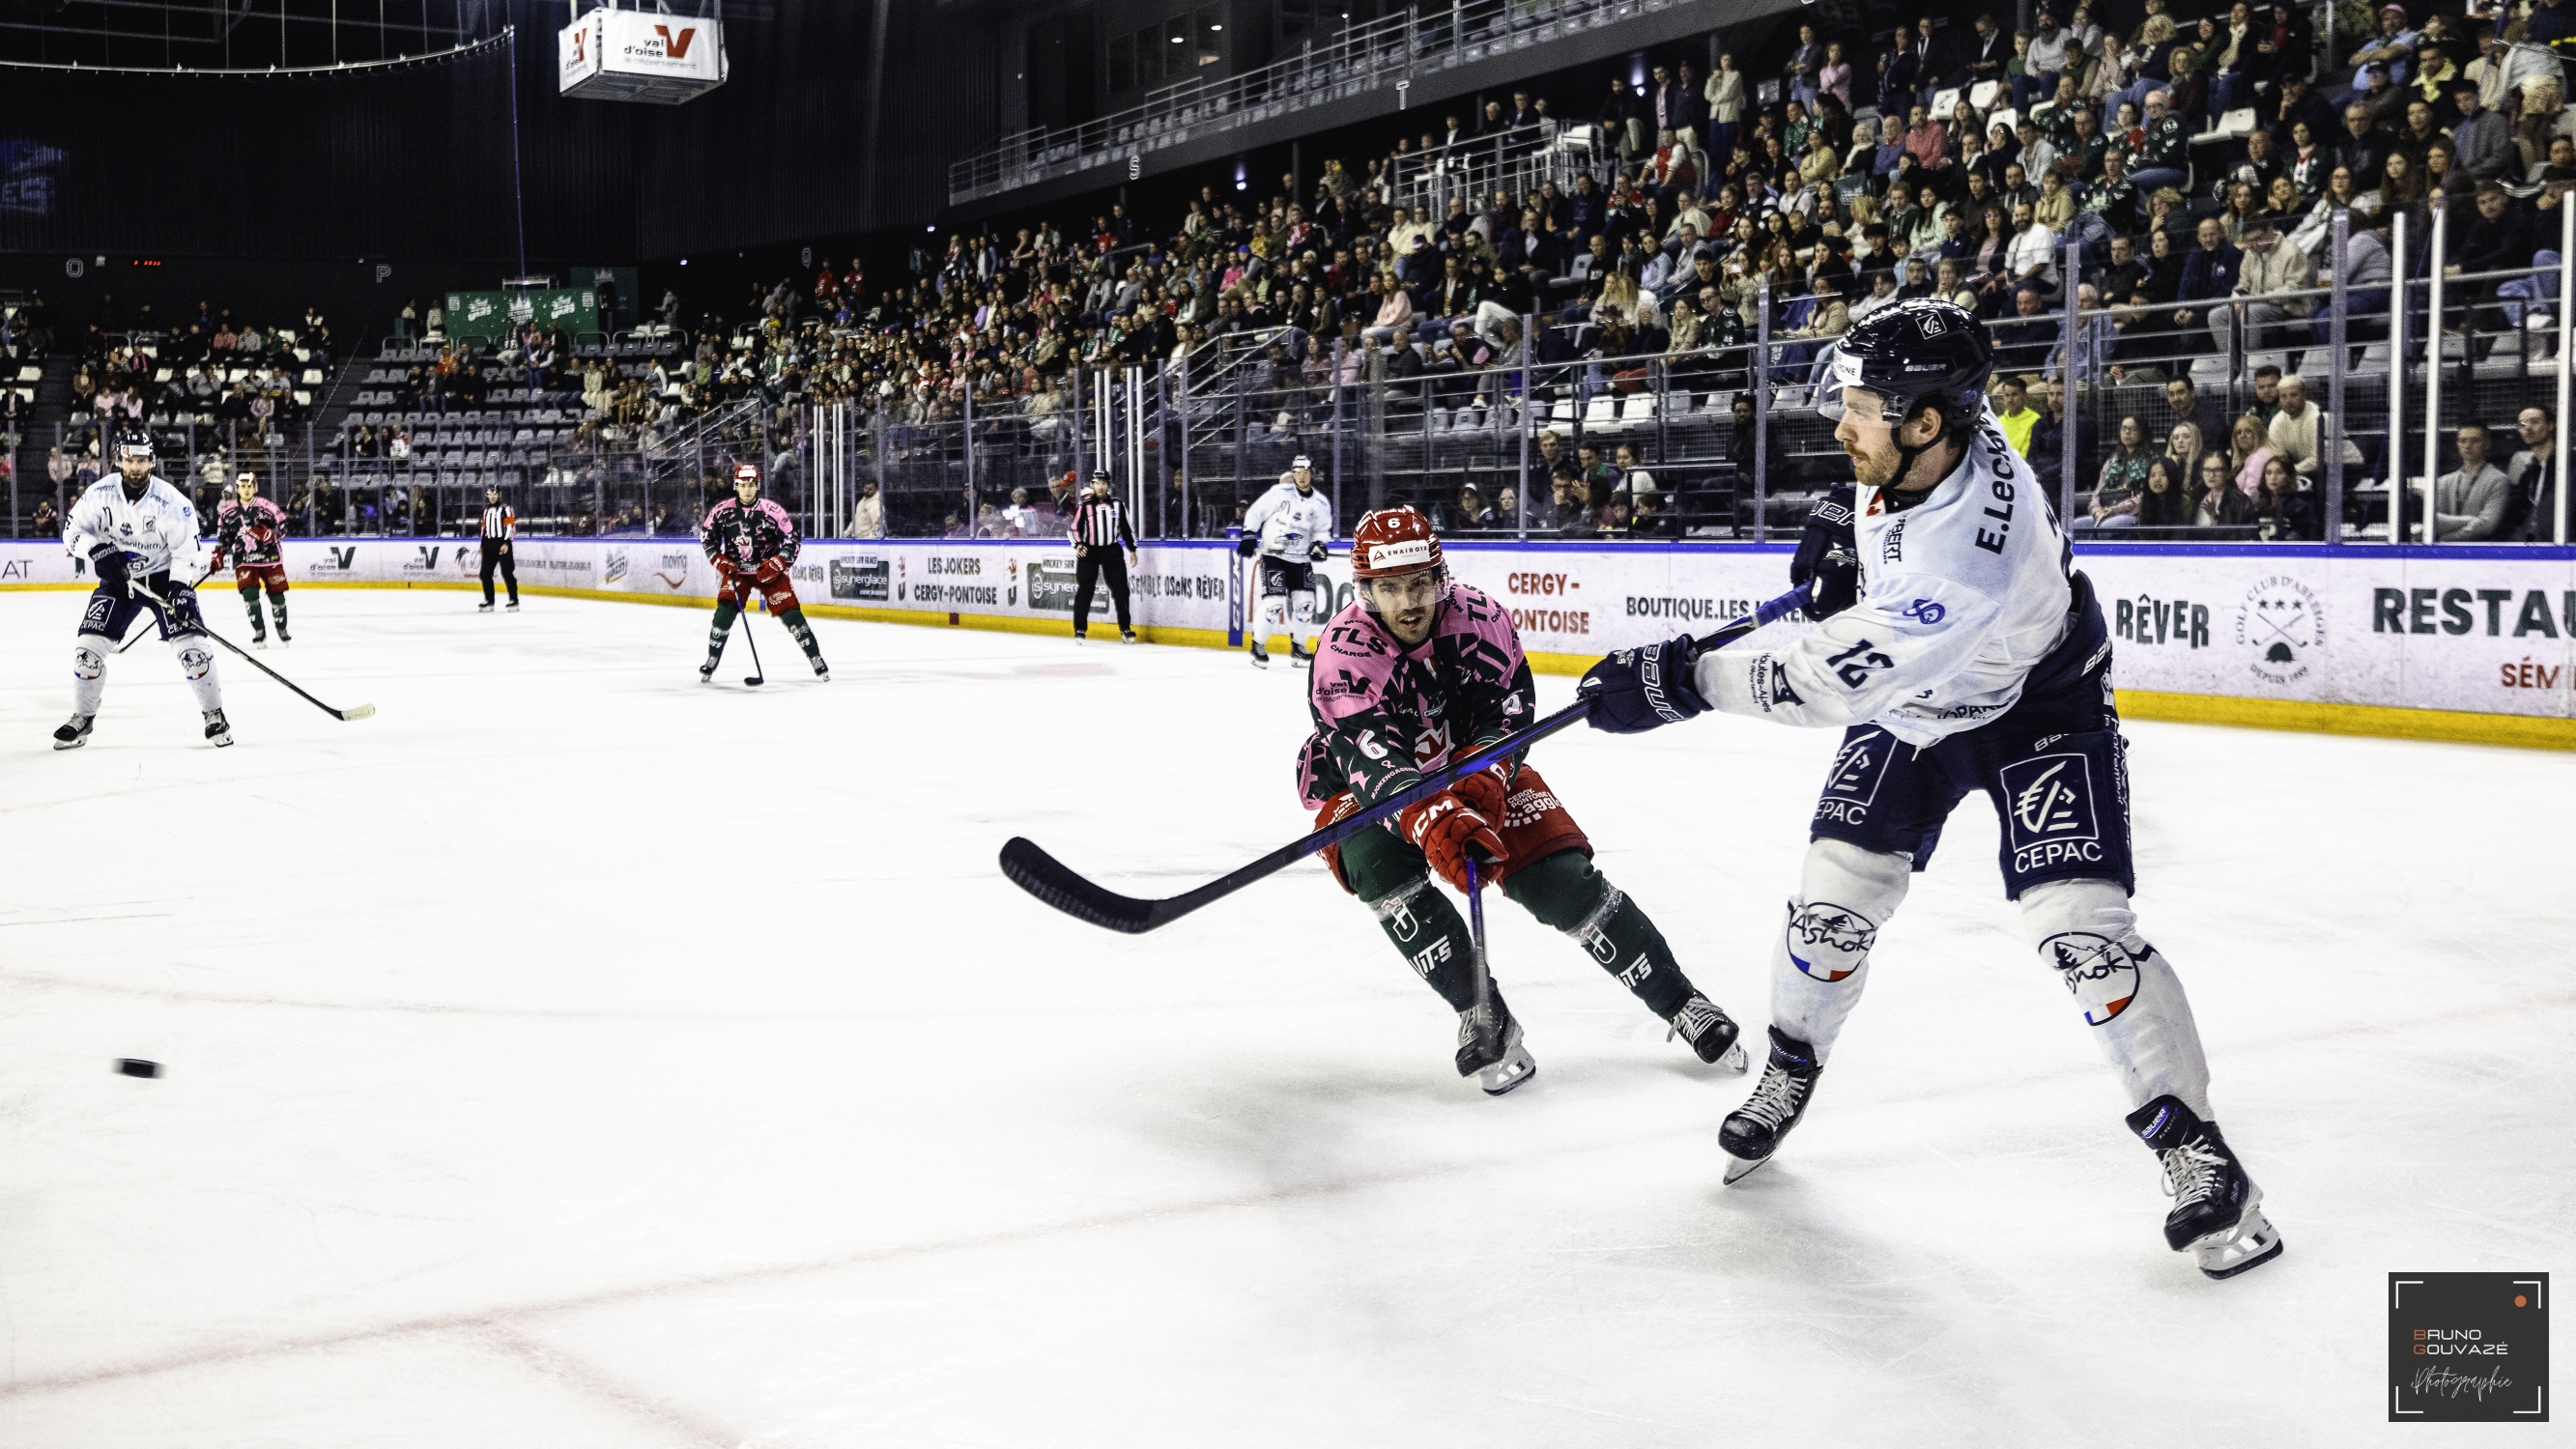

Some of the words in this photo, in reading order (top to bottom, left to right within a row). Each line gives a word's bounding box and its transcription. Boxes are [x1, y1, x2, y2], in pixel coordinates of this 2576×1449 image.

[624, 46, 664, 58] d'oise
[644, 39, 664, 47] val
[376, 264, 391, 282] P
[1388, 518, 1401, 528] 6
[0, 559, 33, 580] AT
[928, 557, 942, 574] LES
[944, 558, 981, 575] JOKERS
[1043, 559, 1063, 569] HOCKEY
[1065, 560, 1075, 569] SUR
[841, 574, 887, 587] synerglace
[1044, 582, 1107, 594] synerce
[2247, 577, 2277, 601] CLUB
[914, 584, 997, 605] CERGY-PONTOISE
[1507, 608, 1589, 635] ONTOISE
[2116, 593, 2210, 649] RÊVER
[2235, 603, 2247, 644] GOLF
[1331, 627, 1388, 655] TLS
[1331, 644, 1372, 657] CHARGE
[1826, 639, 1894, 690] 12
[2249, 663, 2285, 684] DEPUIS
[1316, 687, 1347, 696] d'oise
[1749, 665, 1759, 704] département
[1757, 652, 1772, 713] Hautes-Alpes
[1356, 729, 1388, 760] 6
[1813, 800, 1867, 825] EPAC
[2015, 841, 2104, 873] CEPAC
